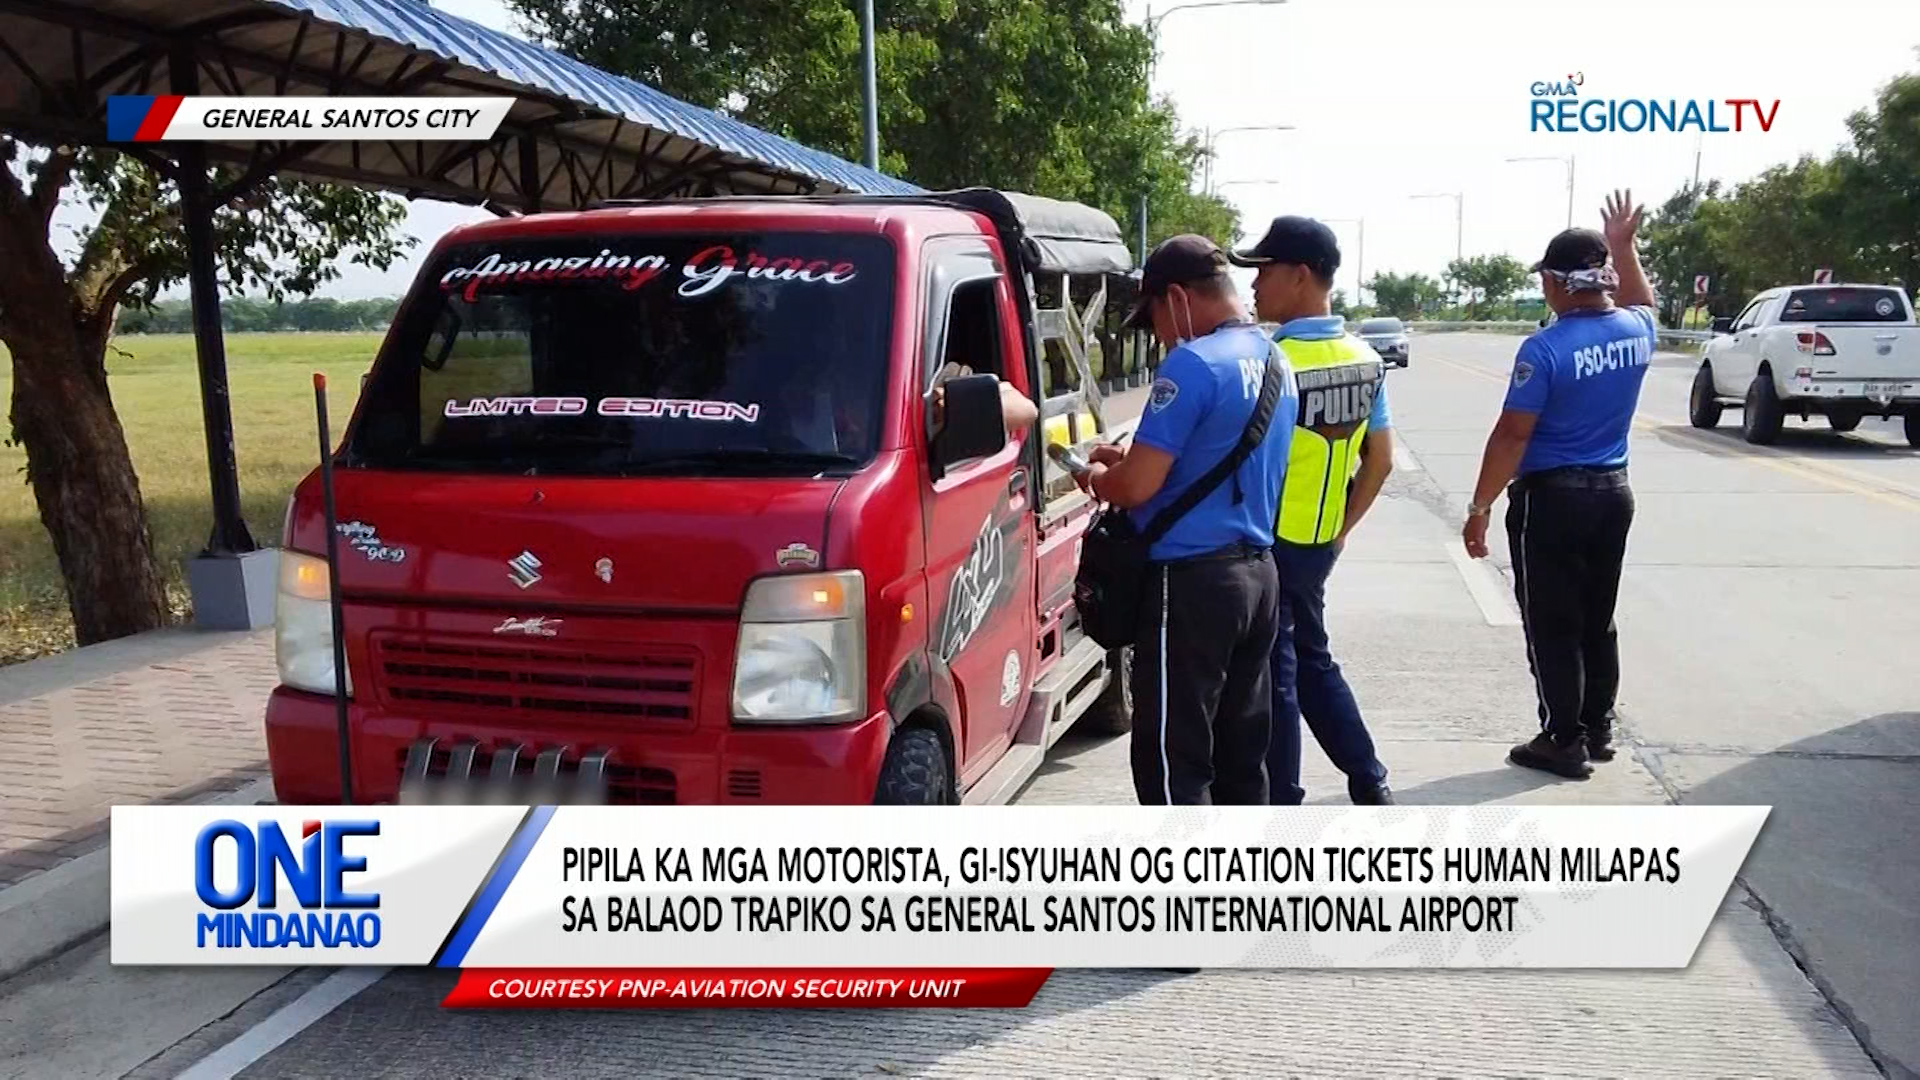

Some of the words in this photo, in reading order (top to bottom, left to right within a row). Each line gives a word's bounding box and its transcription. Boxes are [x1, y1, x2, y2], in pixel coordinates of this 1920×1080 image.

[438, 248, 671, 303] Amazing
[677, 245, 858, 297] Grace
[444, 397, 588, 417] LIMITED
[597, 397, 758, 421] EDITION
[1304, 383, 1373, 427] PULIS
